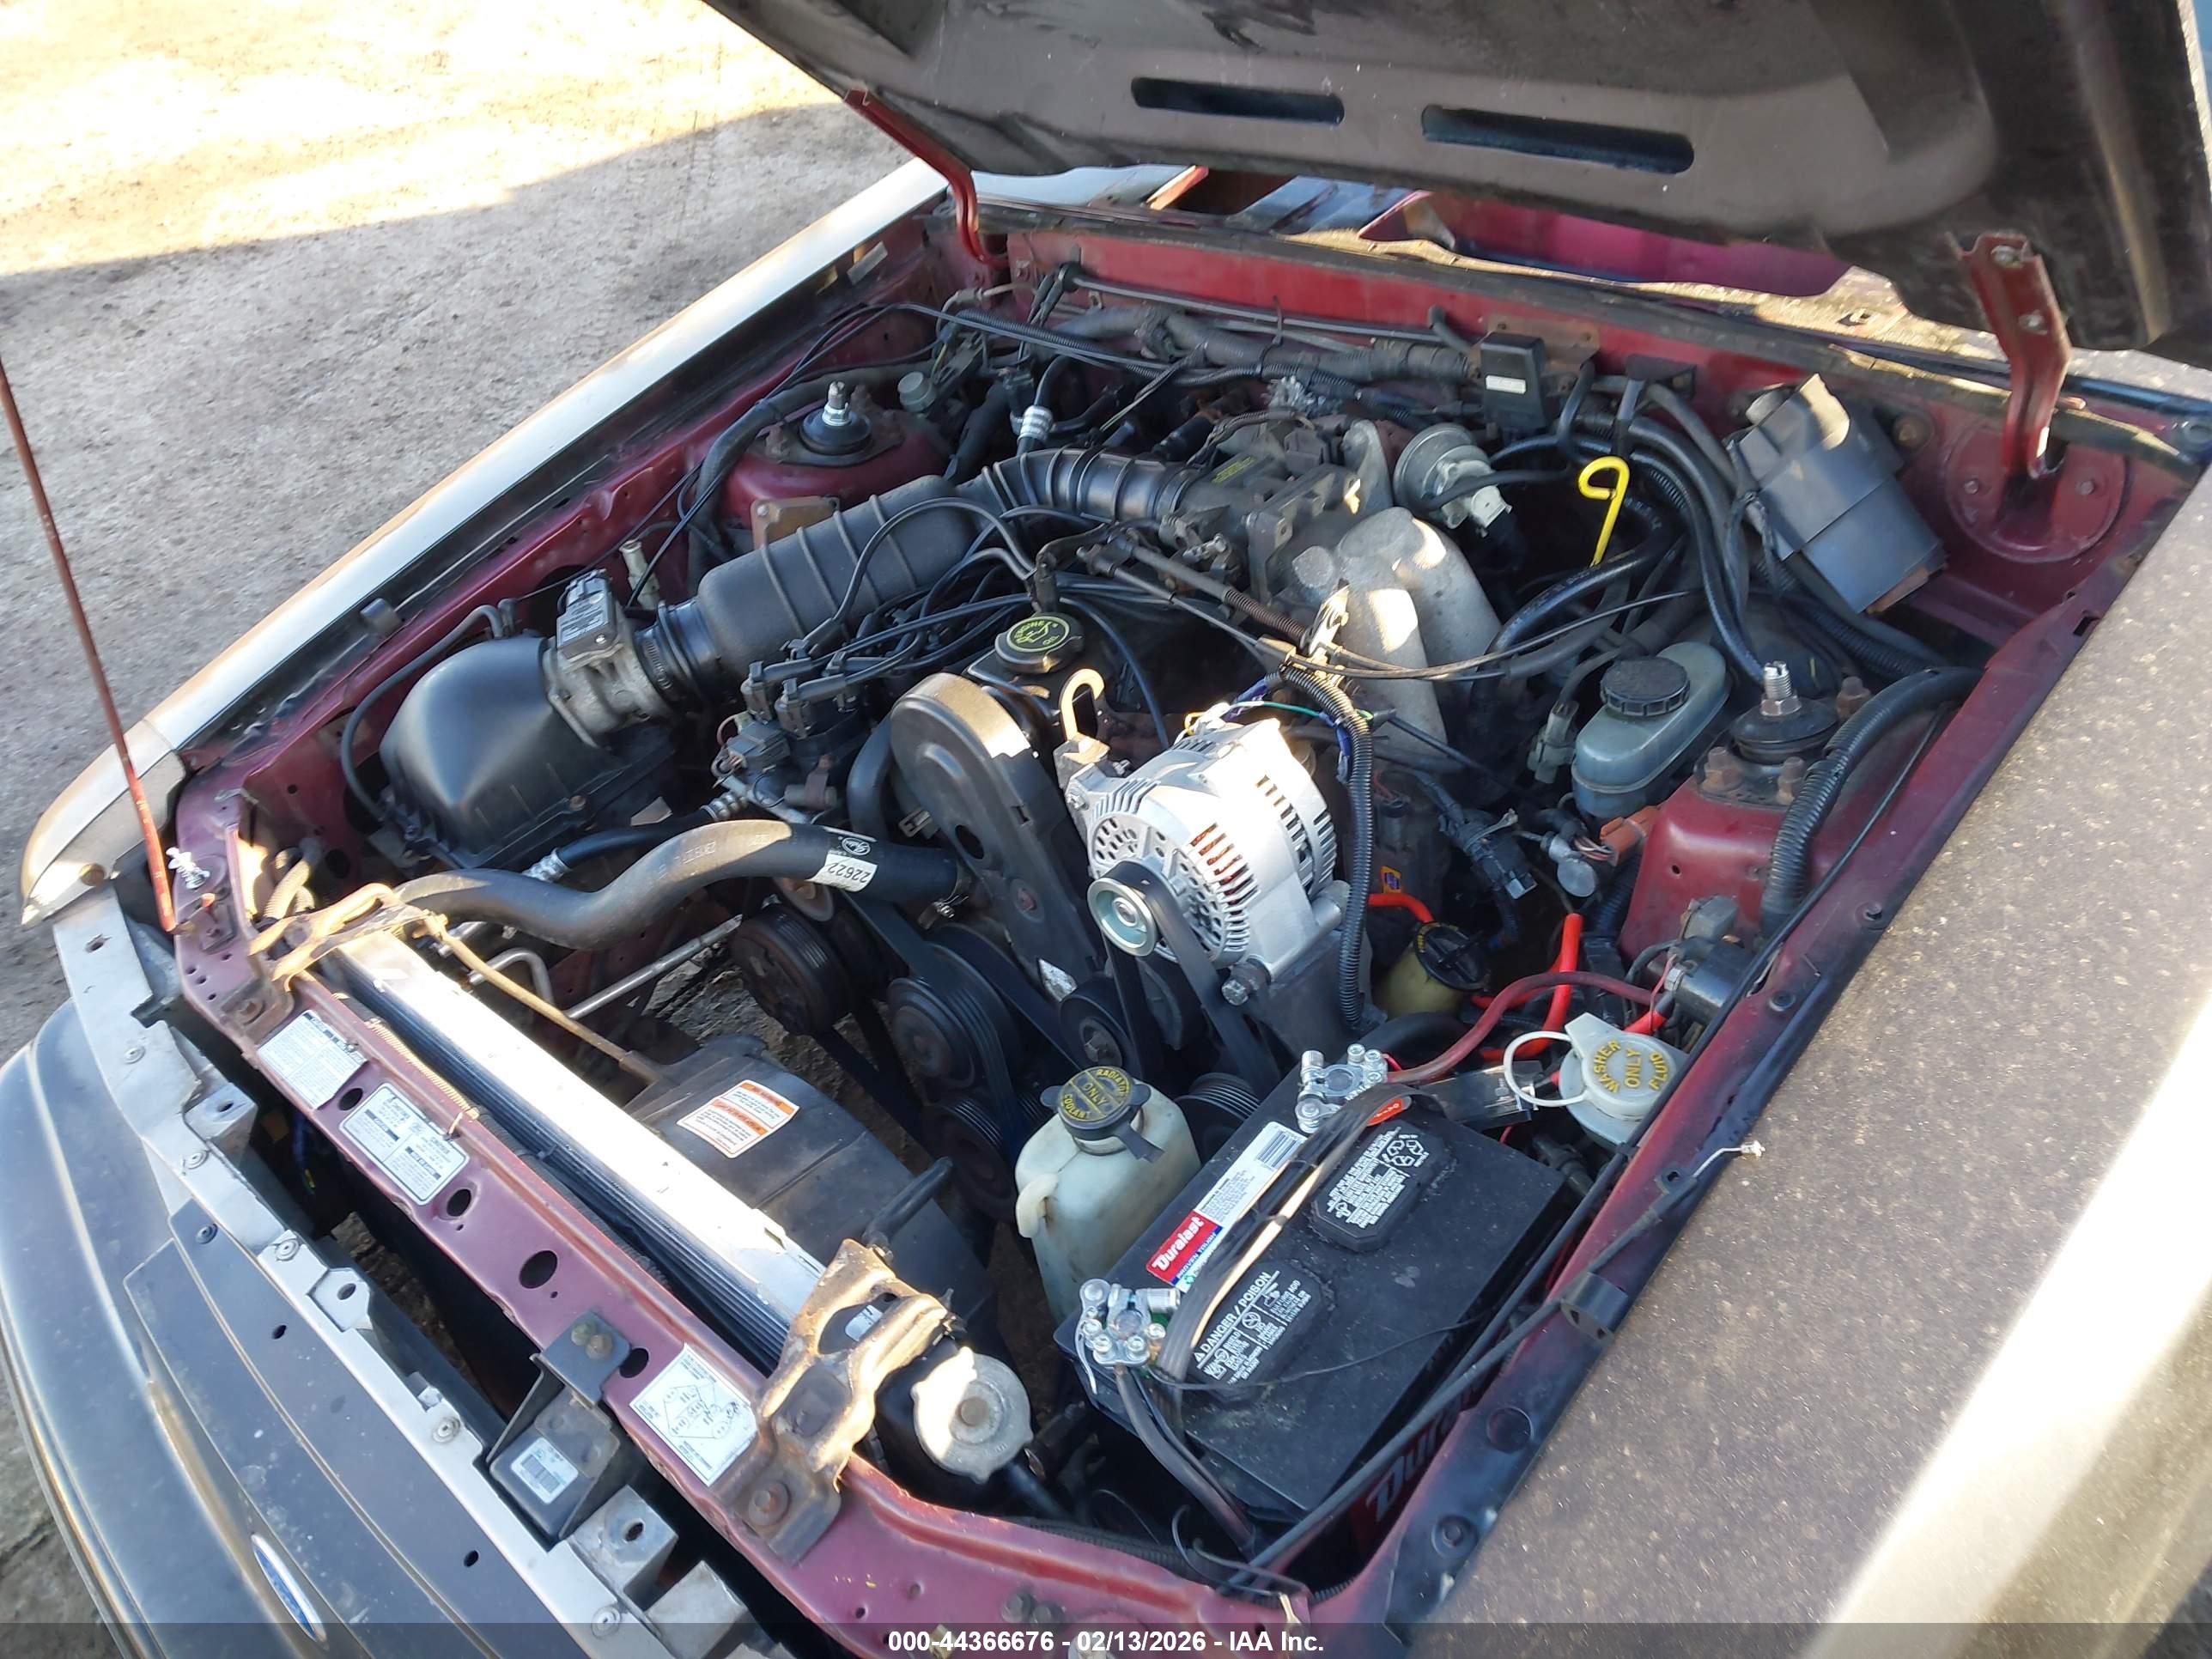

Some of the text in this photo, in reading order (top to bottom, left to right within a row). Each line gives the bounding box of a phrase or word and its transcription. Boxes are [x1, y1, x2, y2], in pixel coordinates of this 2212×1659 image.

[1014, 620, 1045, 638] ENGINE
[1042, 635, 1060, 646] OIL
[827, 862, 871, 884] 22622
[1594, 1039, 1621, 1092] WASHER
[1625, 1048, 1642, 1087] ONLY
[1649, 1052, 1668, 1090] FLUID
[1083, 1082, 1108, 1106] ONLY
[1152, 1214, 1204, 1270] Duralast
[1176, 1252, 1200, 1279] PROVEN
[1200, 1311, 1237, 1352] DANGER
[1234, 1304, 1240, 1315] /
[1237, 1271, 1271, 1307] POISON
